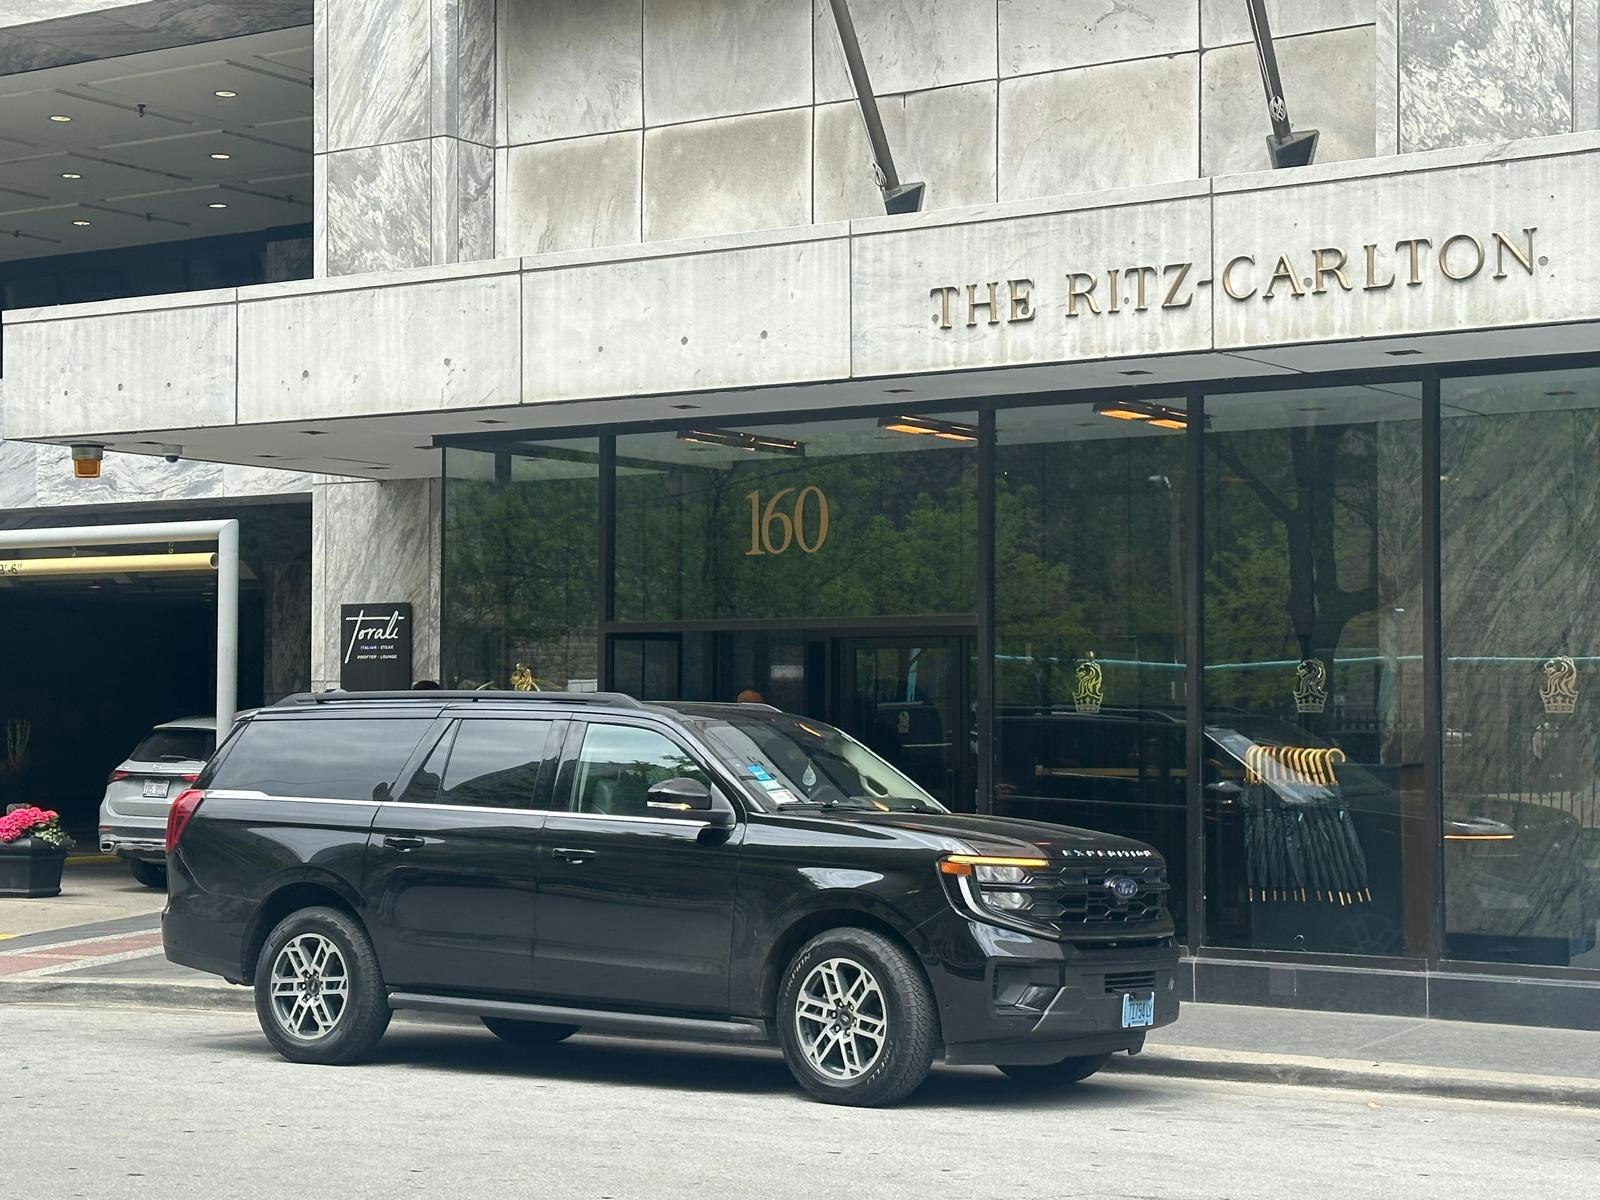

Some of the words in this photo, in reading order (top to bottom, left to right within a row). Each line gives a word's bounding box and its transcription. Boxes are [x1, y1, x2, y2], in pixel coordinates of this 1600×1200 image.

[930, 278, 1036, 330] THE
[1065, 226, 1538, 318] RITZ-CARLTON
[744, 485, 829, 555] 160
